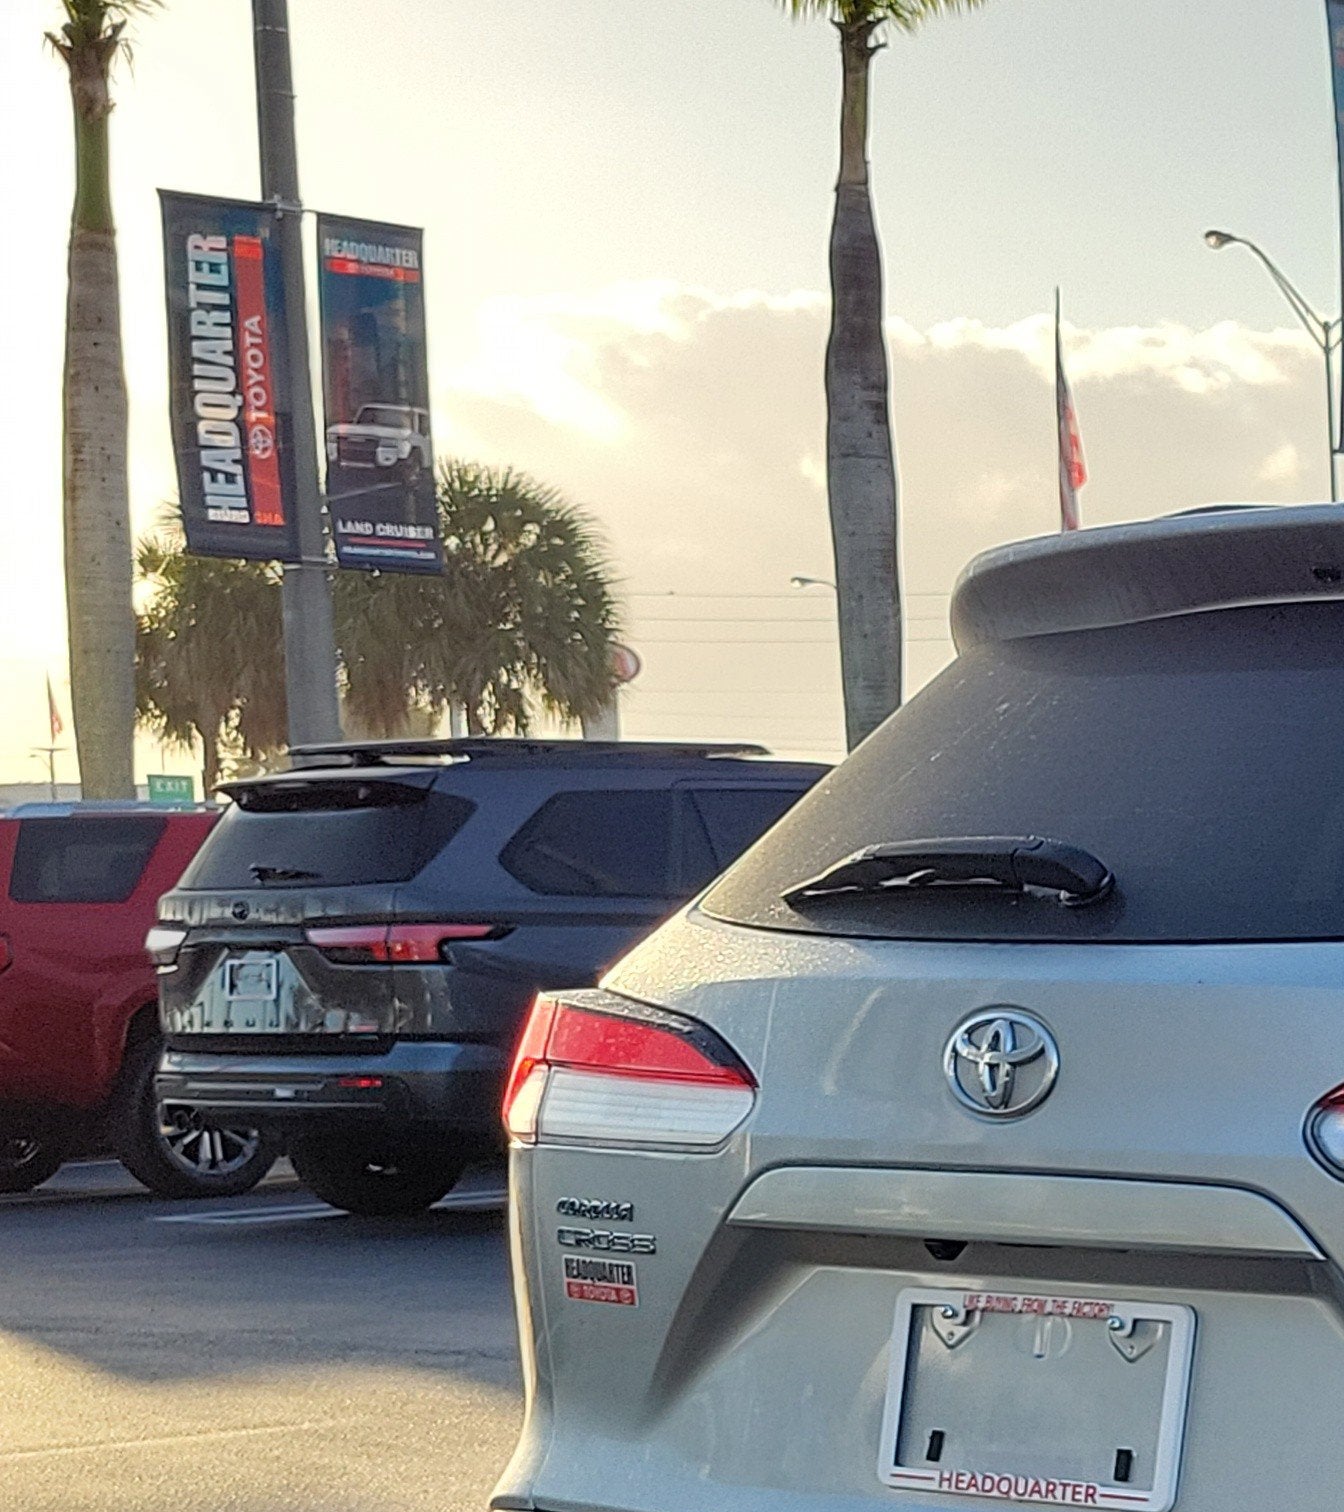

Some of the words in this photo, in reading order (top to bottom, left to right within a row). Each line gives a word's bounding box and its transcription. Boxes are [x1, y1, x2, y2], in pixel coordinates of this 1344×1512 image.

[324, 238, 420, 269] HEADQUARTER
[187, 232, 251, 524] HEADQUARTER
[243, 314, 269, 424] TOYOTA
[336, 519, 374, 536] LAND
[375, 522, 434, 540] CRUISER
[155, 779, 188, 792] EXIT
[557, 1226, 656, 1254] CROSS
[938, 1471, 1098, 1505] HEADQUARTER
